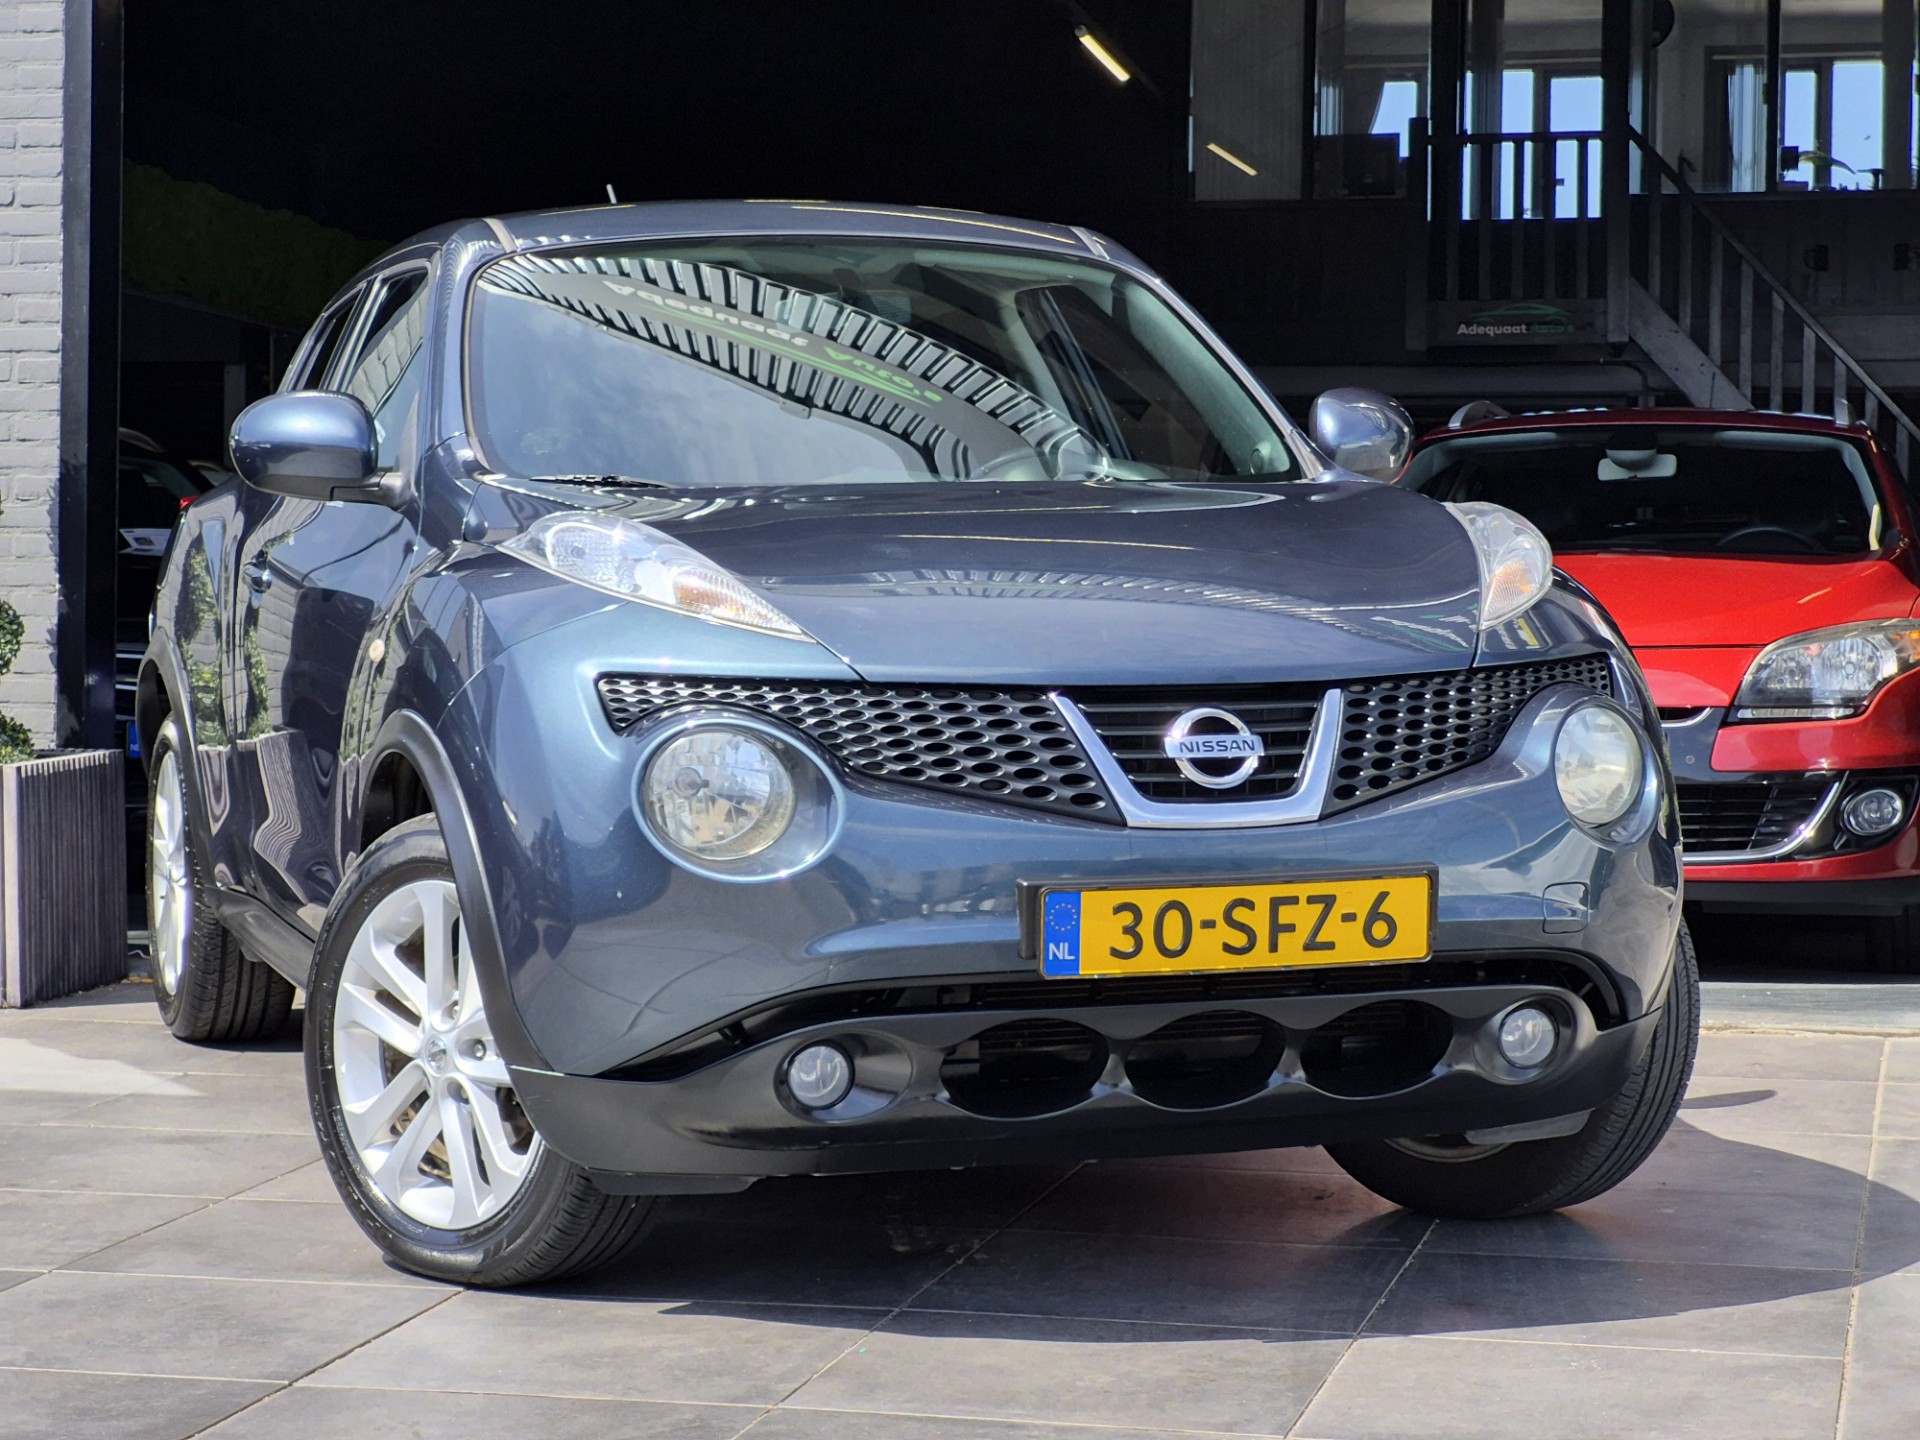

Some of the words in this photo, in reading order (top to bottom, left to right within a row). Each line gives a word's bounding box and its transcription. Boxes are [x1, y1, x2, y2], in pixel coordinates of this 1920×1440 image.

[1457, 323, 1527, 336] Adequaat
[1178, 740, 1255, 753] NISSAN
[1109, 891, 1397, 959] 30-SFZ-6
[1049, 943, 1075, 960] NL
